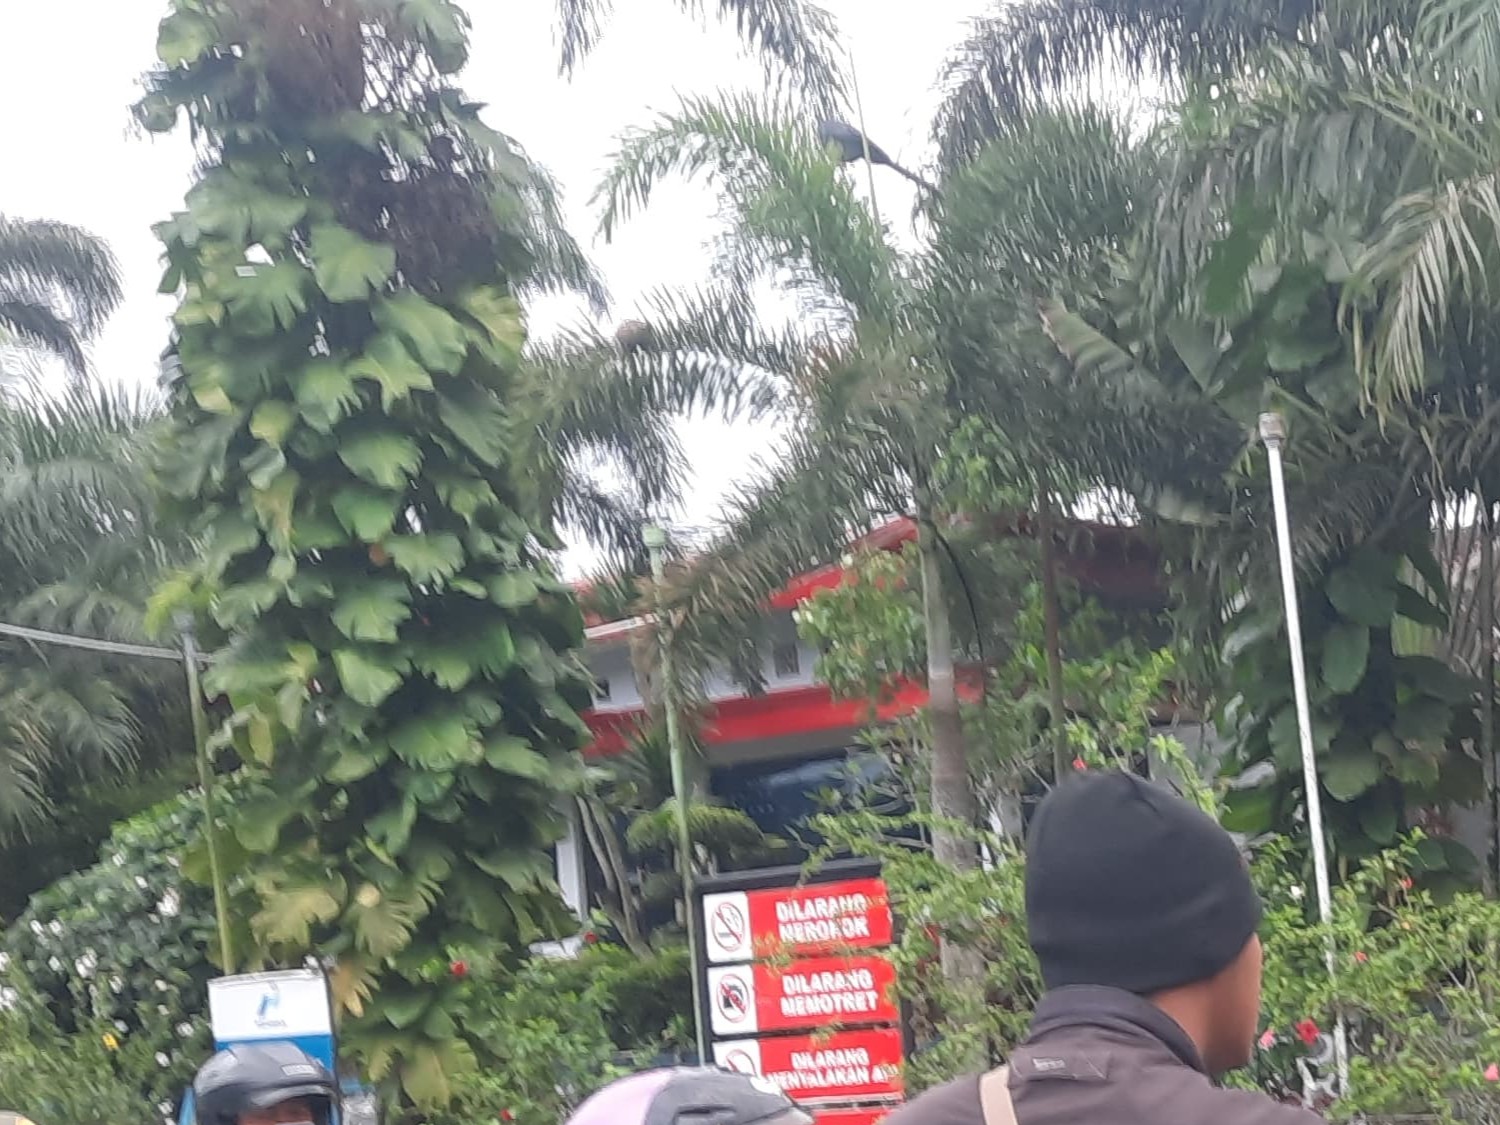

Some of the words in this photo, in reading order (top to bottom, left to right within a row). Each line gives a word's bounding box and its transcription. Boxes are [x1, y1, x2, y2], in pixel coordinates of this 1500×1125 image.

[775, 892, 868, 922] DILARANG
[779, 916, 871, 943] MEROKOK
[782, 967, 875, 996] DILARANG
[780, 990, 879, 1017] MEMOTRET
[790, 1047, 870, 1070] DILARANG
